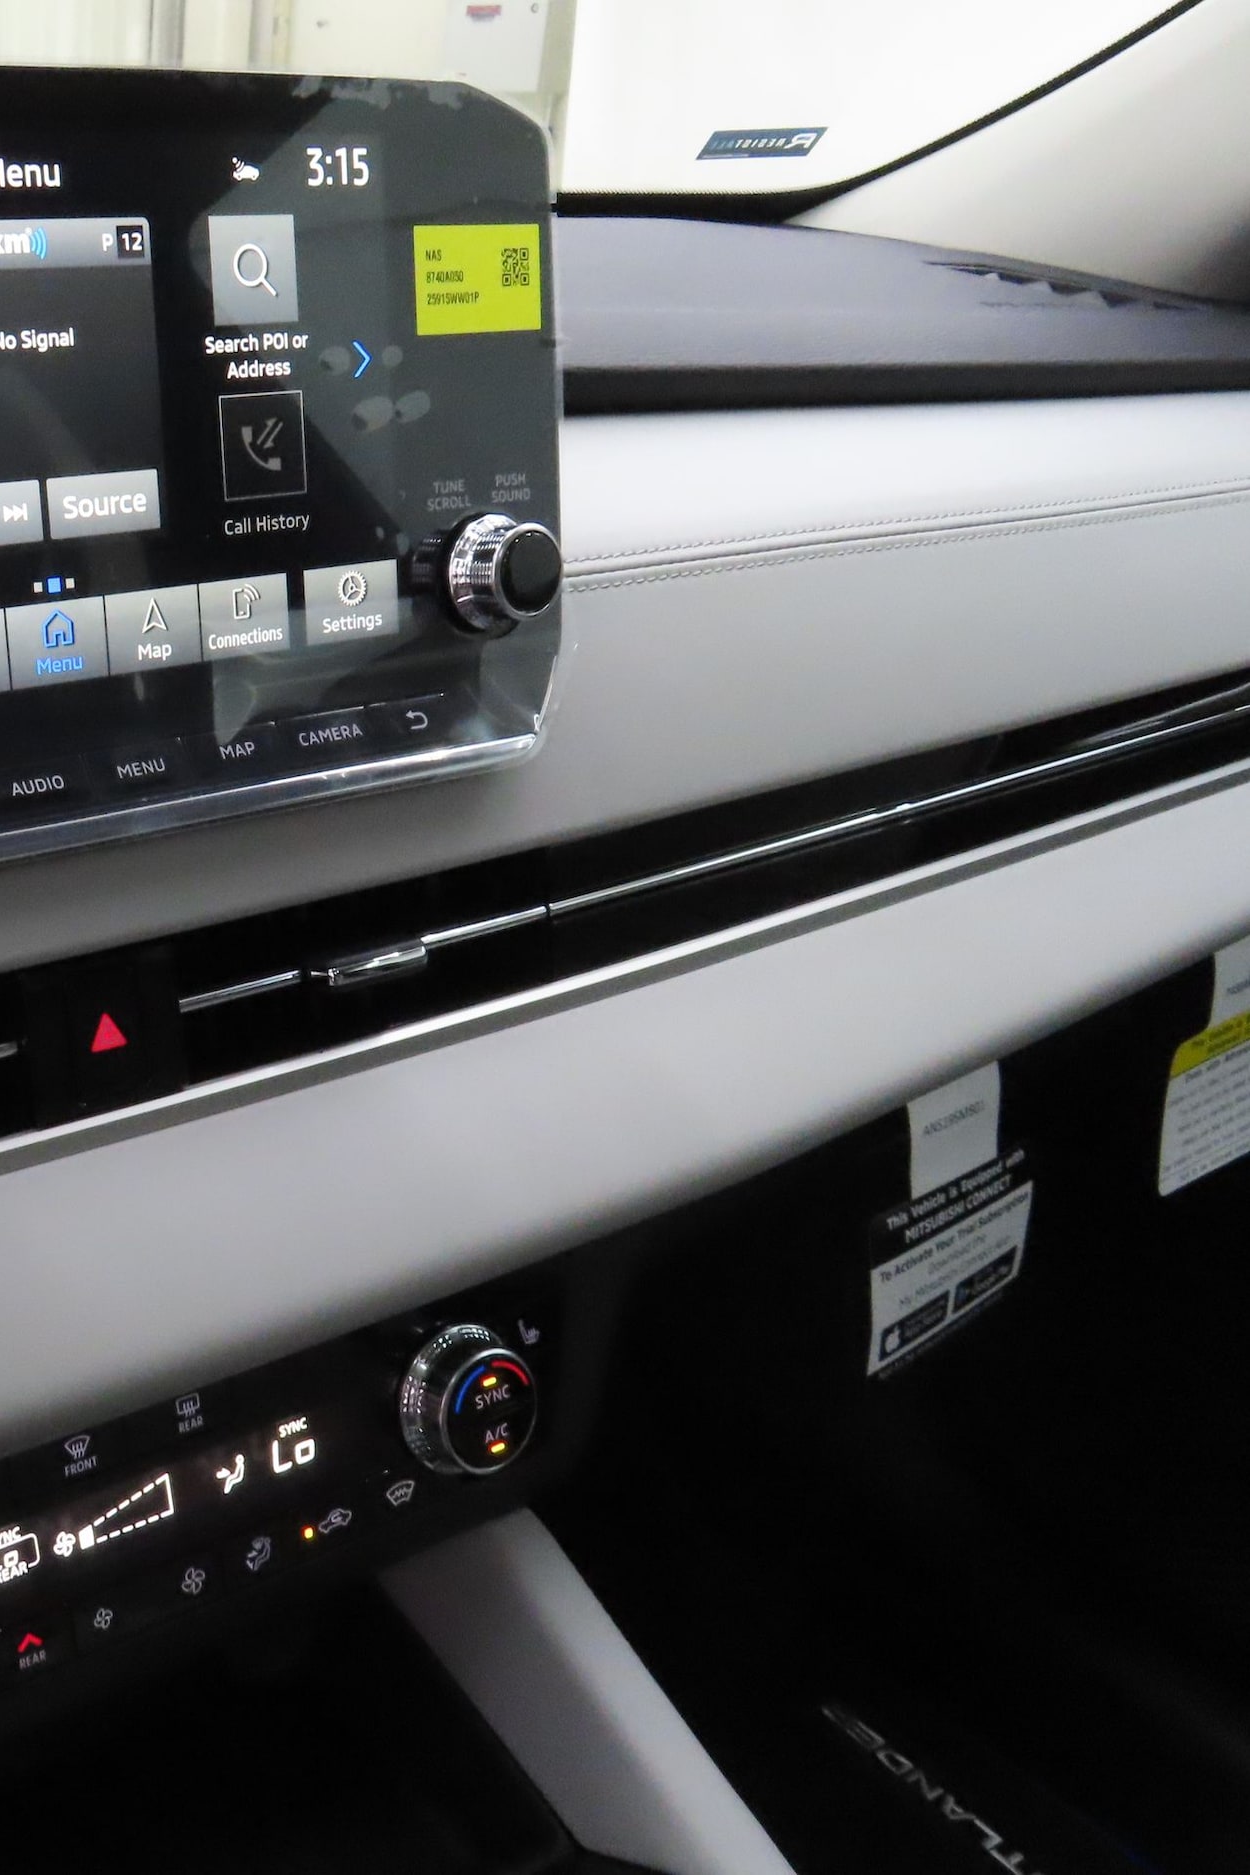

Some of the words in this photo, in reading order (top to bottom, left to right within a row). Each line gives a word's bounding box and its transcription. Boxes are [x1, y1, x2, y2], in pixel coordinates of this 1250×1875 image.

[305, 146, 370, 187] 3:15
[102, 233, 114, 252] P
[120, 232, 144, 254] 12
[425, 249, 442, 262] NAS
[20, 328, 76, 352] Signal
[205, 334, 259, 355] Search
[263, 333, 288, 352] POI
[292, 334, 309, 350] or
[227, 359, 291, 380] Address
[433, 479, 465, 495] TUNE
[495, 474, 526, 488] PUSH
[63, 490, 148, 521] Source
[427, 494, 472, 512] SCROLL
[491, 488, 531, 503] SOUND
[224, 517, 252, 536] Call
[255, 513, 310, 535] History
[322, 610, 383, 634] Settings
[208, 625, 283, 650] Connections
[137, 641, 172, 663] Map
[36, 653, 83, 676] Menu
[298, 724, 363, 748] CAMERA
[219, 741, 255, 760] MAP
[116, 758, 166, 780] MENU
[11, 774, 65, 798] AUDIO
[886, 1211, 909, 1231] This
[909, 1191, 947, 1219] Vehicle
[947, 1185, 959, 1200] is
[904, 1199, 965, 1244] MITSUBISHI
[965, 1173, 1012, 1211] CONNECT
[475, 1384, 511, 1410] SYNC
[178, 1416, 204, 1434] REAR
[277, 1415, 308, 1439] SYNC
[484, 1423, 510, 1443] A/C
[63, 1456, 98, 1478] FRONT
[18, 1649, 48, 1670] REAR
